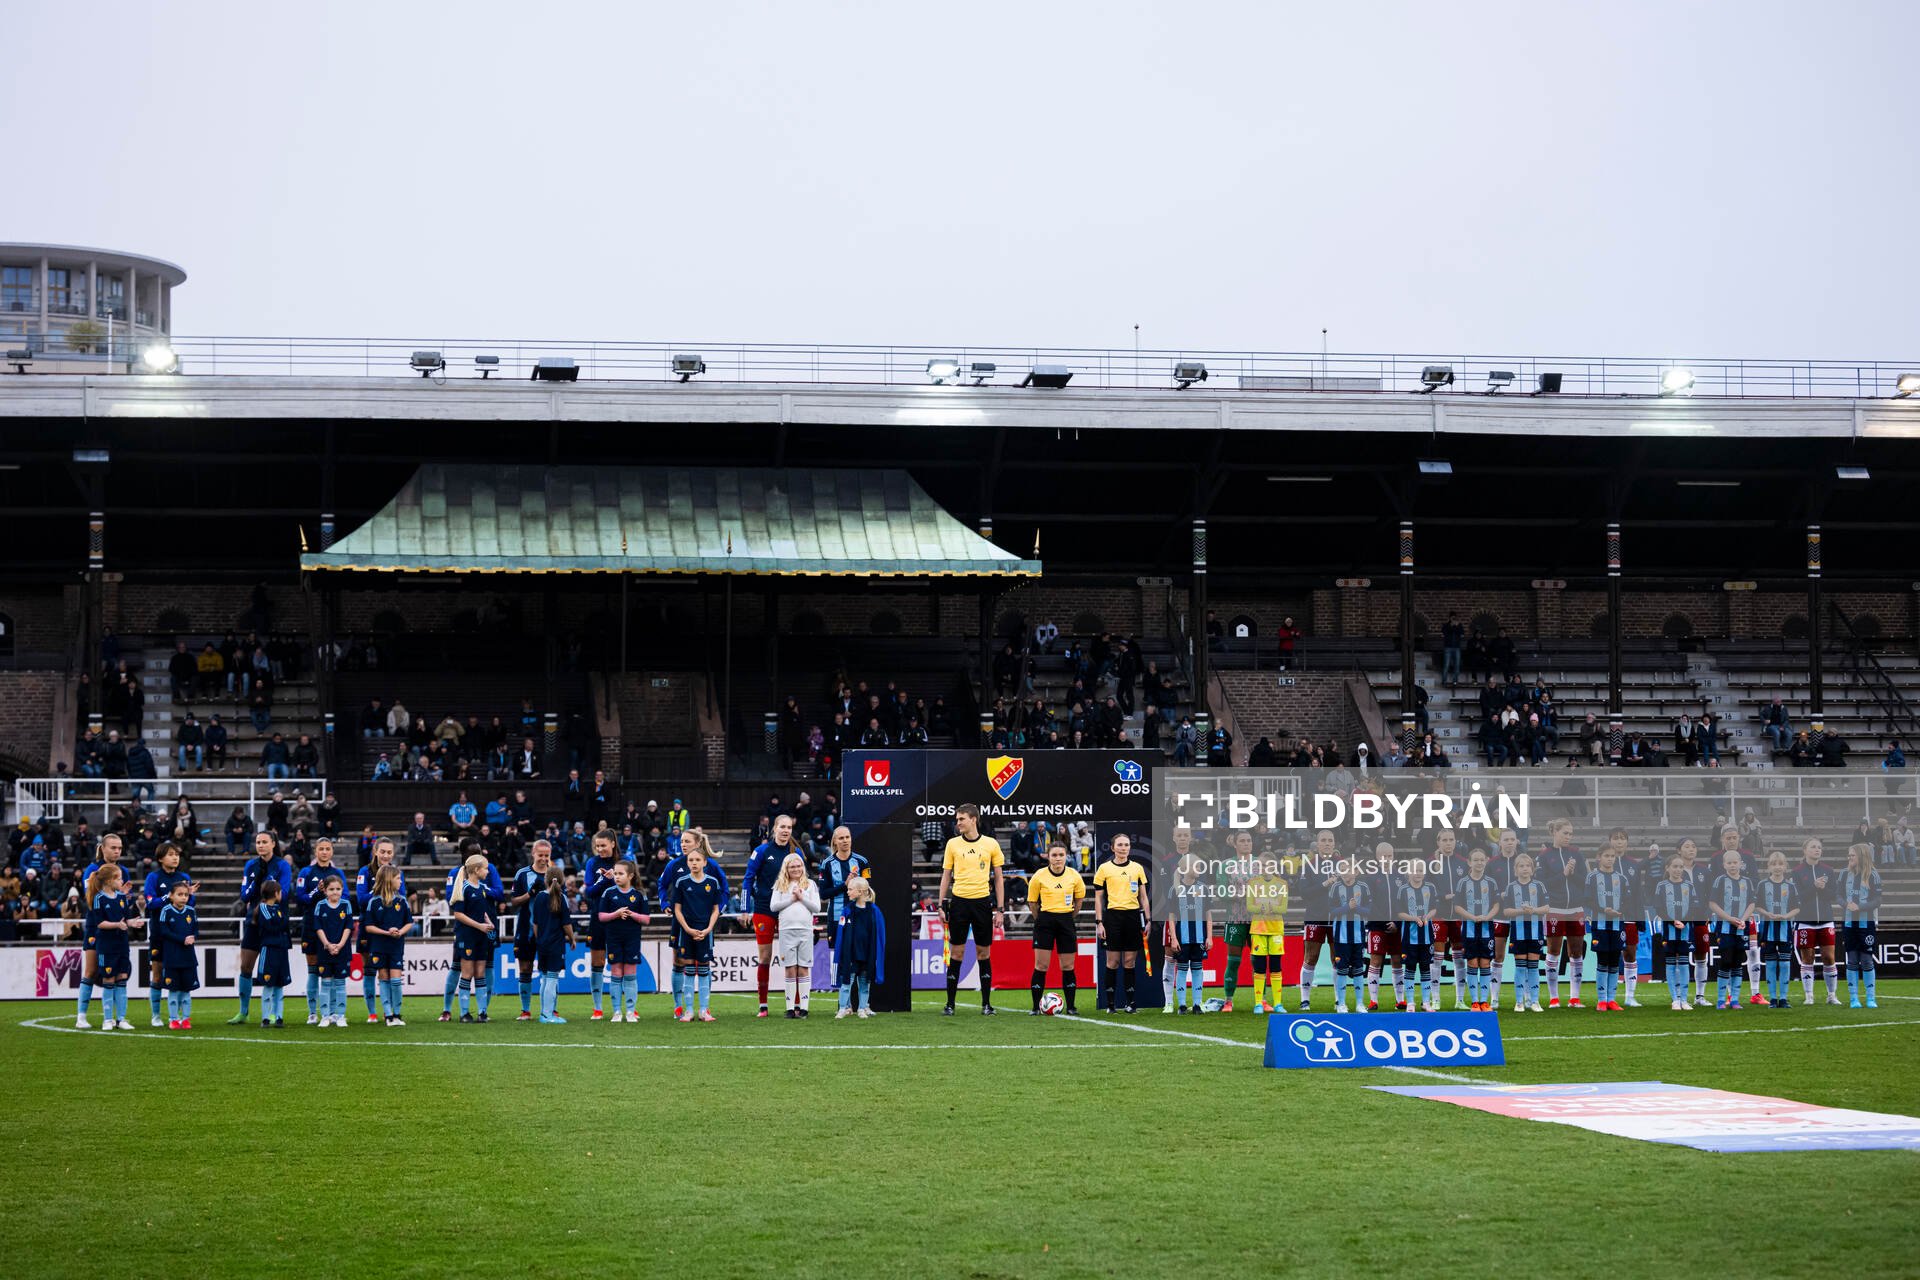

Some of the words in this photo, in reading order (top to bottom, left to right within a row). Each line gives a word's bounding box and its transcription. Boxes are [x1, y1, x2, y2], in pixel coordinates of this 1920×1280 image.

[1745, 746, 1753, 754] 14
[994, 762, 1020, 786] D.I.F.
[851, 788, 885, 796] SVENSKA
[886, 788, 904, 796] SPEL
[1110, 783, 1150, 795] OBOS
[915, 804, 956, 816] OBOS
[980, 804, 1093, 816] MALLSVENSKAN
[1800, 938, 1807, 946] 24
[711, 955, 781, 968] SVENSA
[711, 970, 748, 982] SPEL
[1363, 1029, 1488, 1059] OBOS
